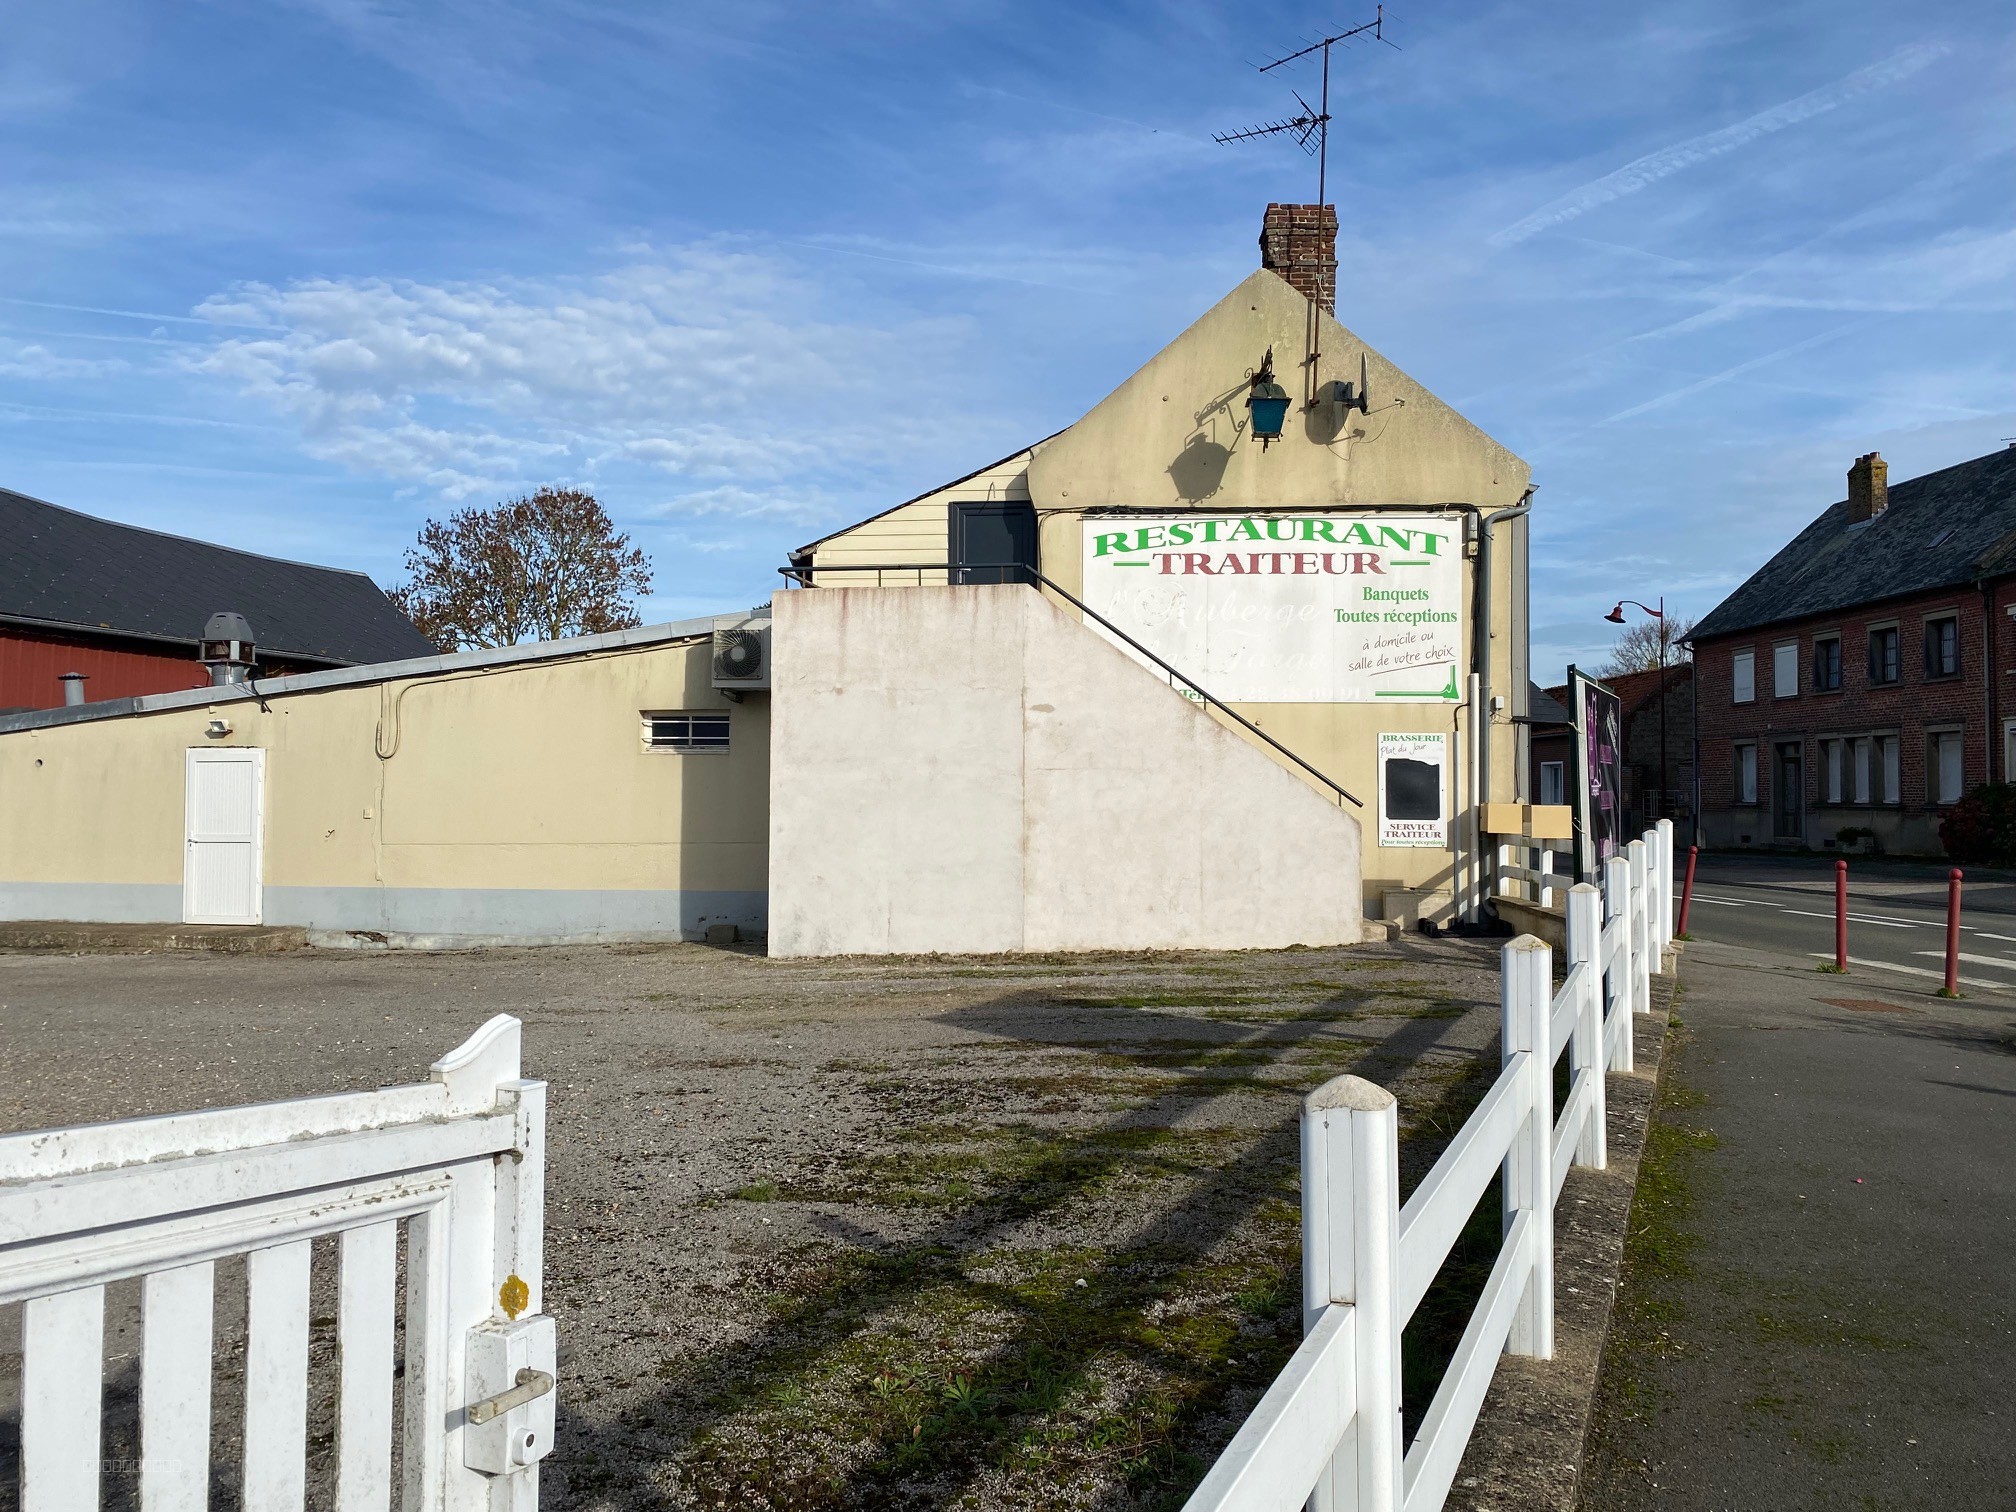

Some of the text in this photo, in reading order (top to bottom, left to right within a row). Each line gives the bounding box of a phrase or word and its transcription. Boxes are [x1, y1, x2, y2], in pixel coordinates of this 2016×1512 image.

[1092, 518, 1449, 558] RESTAURANT
[1152, 552, 1387, 575] TRAITEUR
[1362, 586, 1430, 604] Banquets
[1333, 608, 1458, 627] Toutes réceptions
[1362, 631, 1434, 651] à domicile ou
[1348, 644, 1456, 672] salle de votre choix
[1382, 734, 1443, 742] BRASSERIE
[1397, 743, 1407, 753] du
[1384, 830, 1442, 839] TRAITEUR
[1389, 823, 1437, 831] SERVICE
